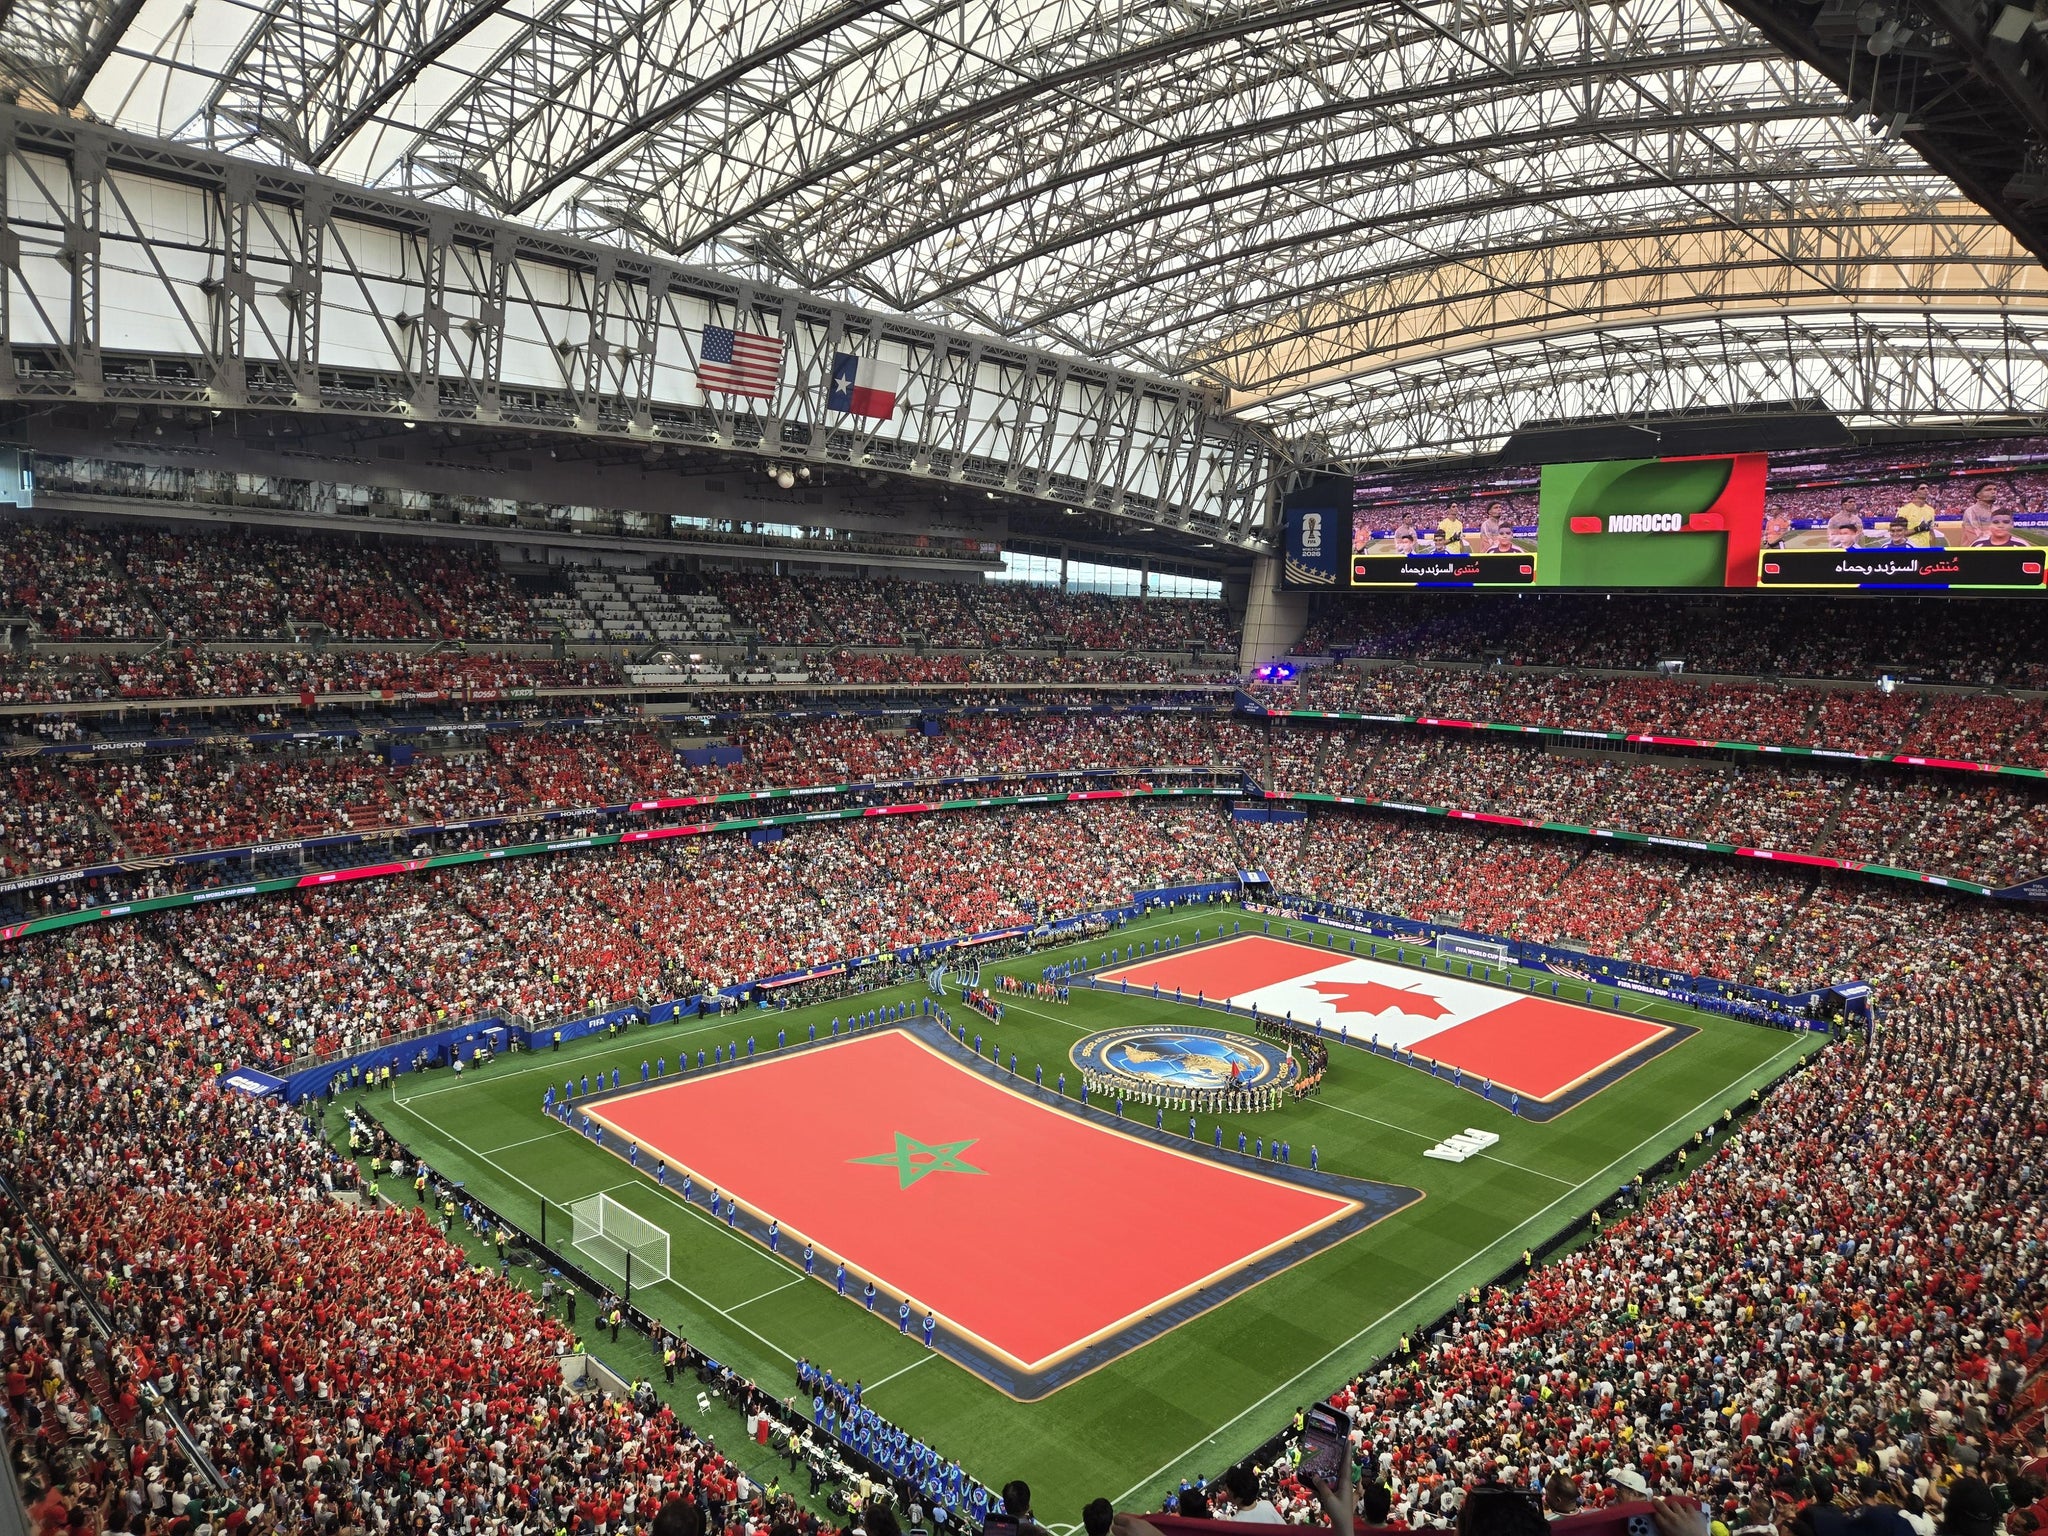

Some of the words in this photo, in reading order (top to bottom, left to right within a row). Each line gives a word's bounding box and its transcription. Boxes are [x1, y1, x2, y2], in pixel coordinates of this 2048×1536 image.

[1608, 513, 1682, 533] MOROCCO
[472, 690, 496, 699] ROSSO
[510, 688, 534, 697] VERDE
[92, 742, 146, 751] HOUSTON
[560, 808, 598, 817] HOUSTON
[251, 842, 302, 854] HOUSTON
[0, 883, 18, 892] FIFA
[18, 878, 44, 890] WORLD
[60, 871, 84, 881] 2026
[1328, 920, 1345, 928] WORLD
[1467, 948, 1486, 958] WORLD
[1618, 980, 1632, 989] FIFA
[1632, 983, 1655, 994] WORLD
[1655, 988, 1668, 996] CUP
[589, 1018, 605, 1028] FIFA
